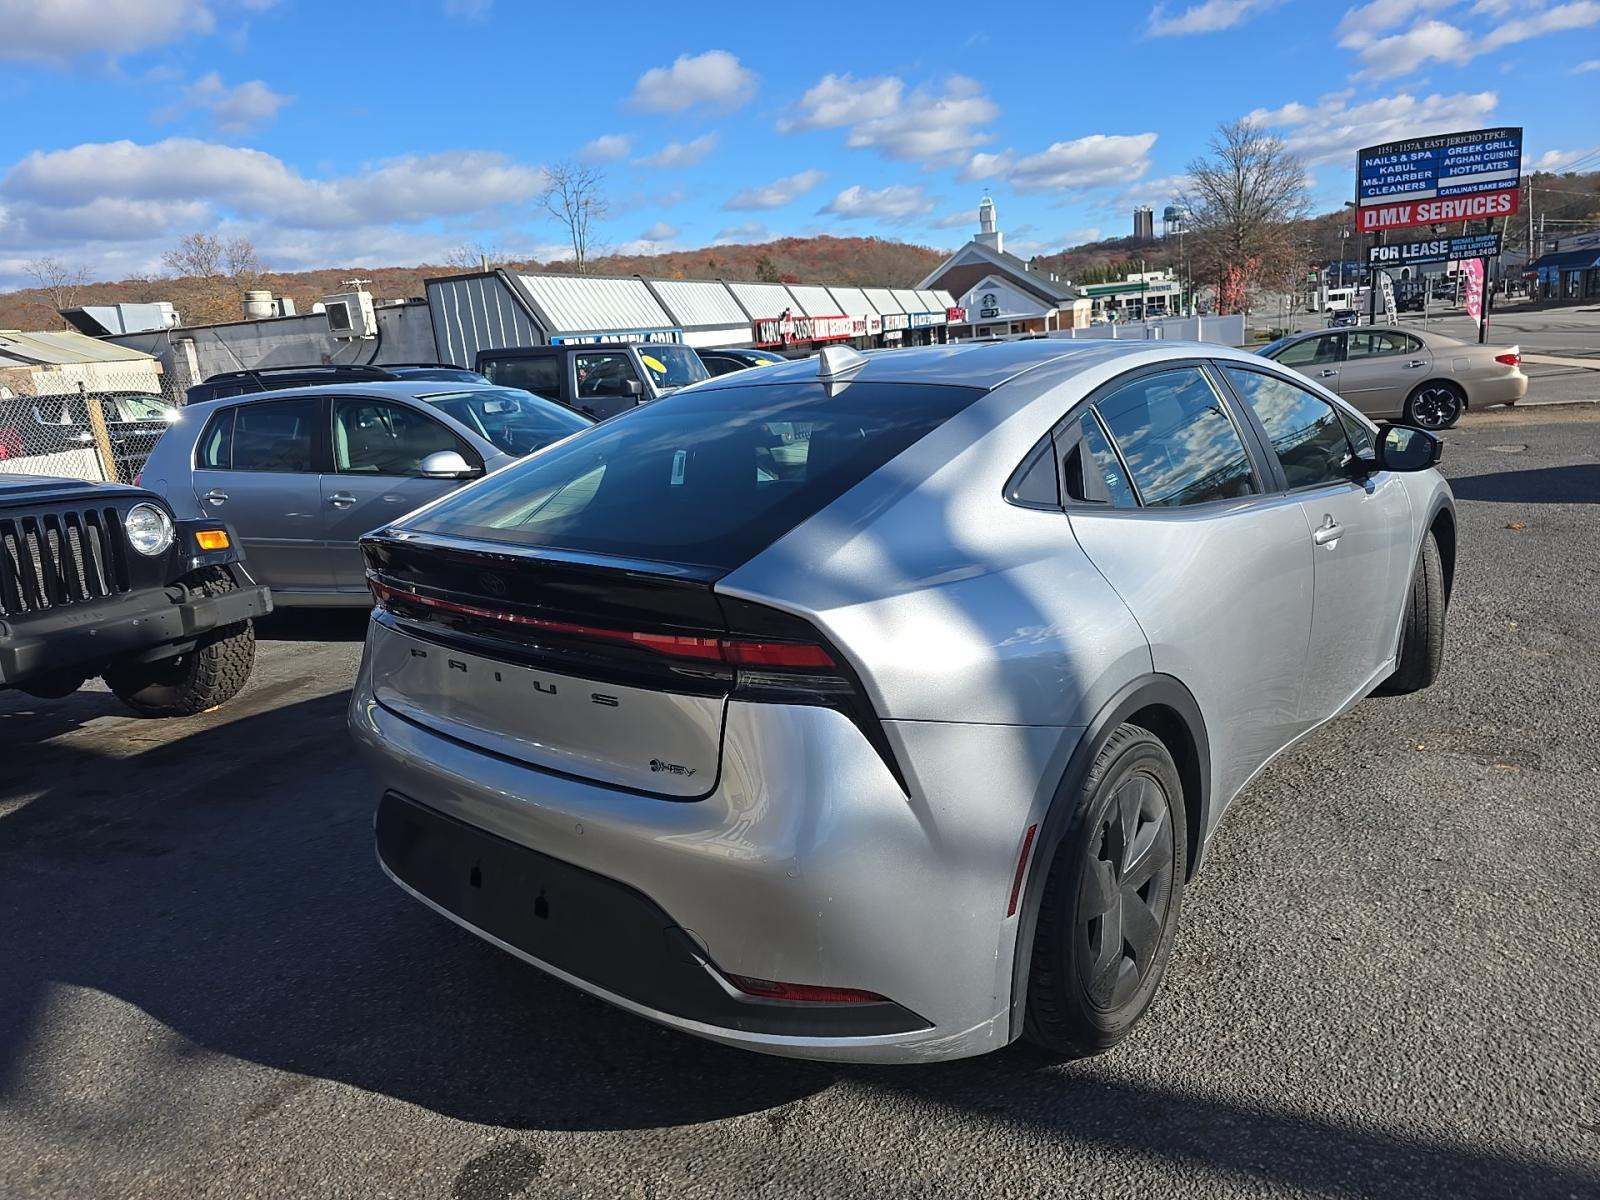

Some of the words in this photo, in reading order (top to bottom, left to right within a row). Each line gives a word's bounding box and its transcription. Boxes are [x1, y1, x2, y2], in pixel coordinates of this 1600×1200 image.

[1378, 145, 1393, 155] 1151
[1424, 139, 1446, 149] EAST
[1446, 134, 1482, 147] JERICHO
[1448, 144, 1482, 156] GREEK
[1484, 140, 1515, 151] GRILL
[1365, 155, 1398, 167] NAILS
[1400, 154, 1408, 162] &
[1410, 151, 1432, 160] SPA
[1444, 154, 1481, 166] AFGHAN
[1483, 149, 1520, 161] CUISINE
[1379, 163, 1417, 174] KABUL
[1449, 165, 1472, 176] HOT
[1472, 160, 1509, 172] PILATES
[1362, 178, 1384, 187] M&J
[1387, 170, 1433, 184] BARBER
[1368, 181, 1426, 196] CLEANERS
[1440, 185, 1478, 196] CATALINA'S
[1478, 182, 1498, 191] BAKE
[1498, 180, 1517, 189] SHOP
[1364, 205, 1411, 228] D.M.V.
[1416, 194, 1511, 222] SERVICES
[1370, 246, 1400, 262] FOR
[1402, 240, 1449, 258] LEASE
[1452, 244, 1467, 252] MIKE
[410, 647, 619, 708] PRIUS
